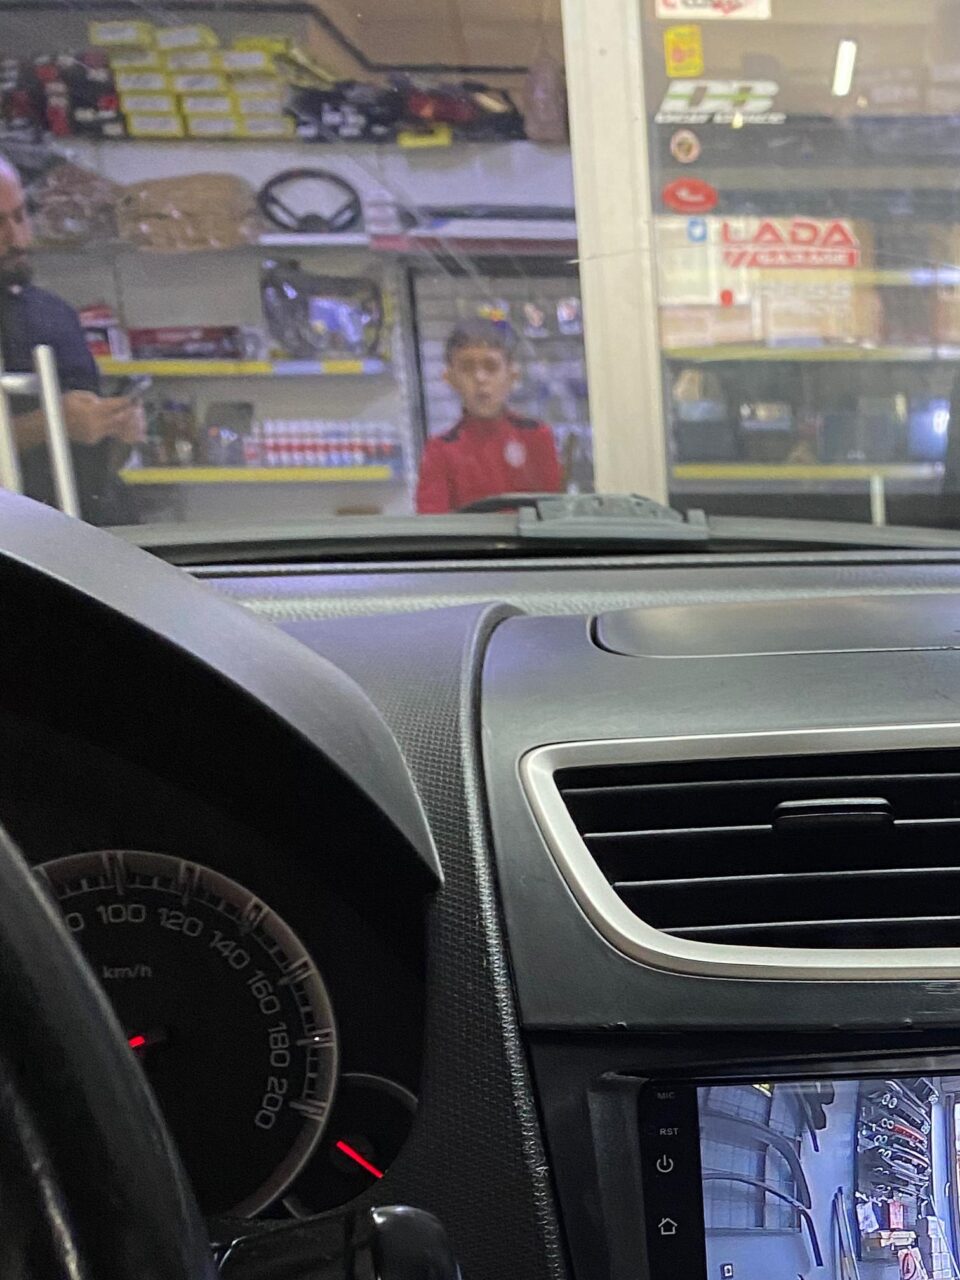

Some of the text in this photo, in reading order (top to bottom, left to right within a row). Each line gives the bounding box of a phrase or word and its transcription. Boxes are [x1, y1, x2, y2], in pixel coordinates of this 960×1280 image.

[722, 221, 856, 246] LADA
[96, 903, 147, 925] 100
[158, 907, 204, 937] 120
[210, 930, 251, 970] 140
[102, 964, 153, 980] km/h
[246, 969, 281, 1015] 160
[267, 1021, 290, 1068] 180
[254, 1076, 289, 1130] 200
[656, 1091, 675, 1100] MIC
[659, 1127, 679, 1136] RST
